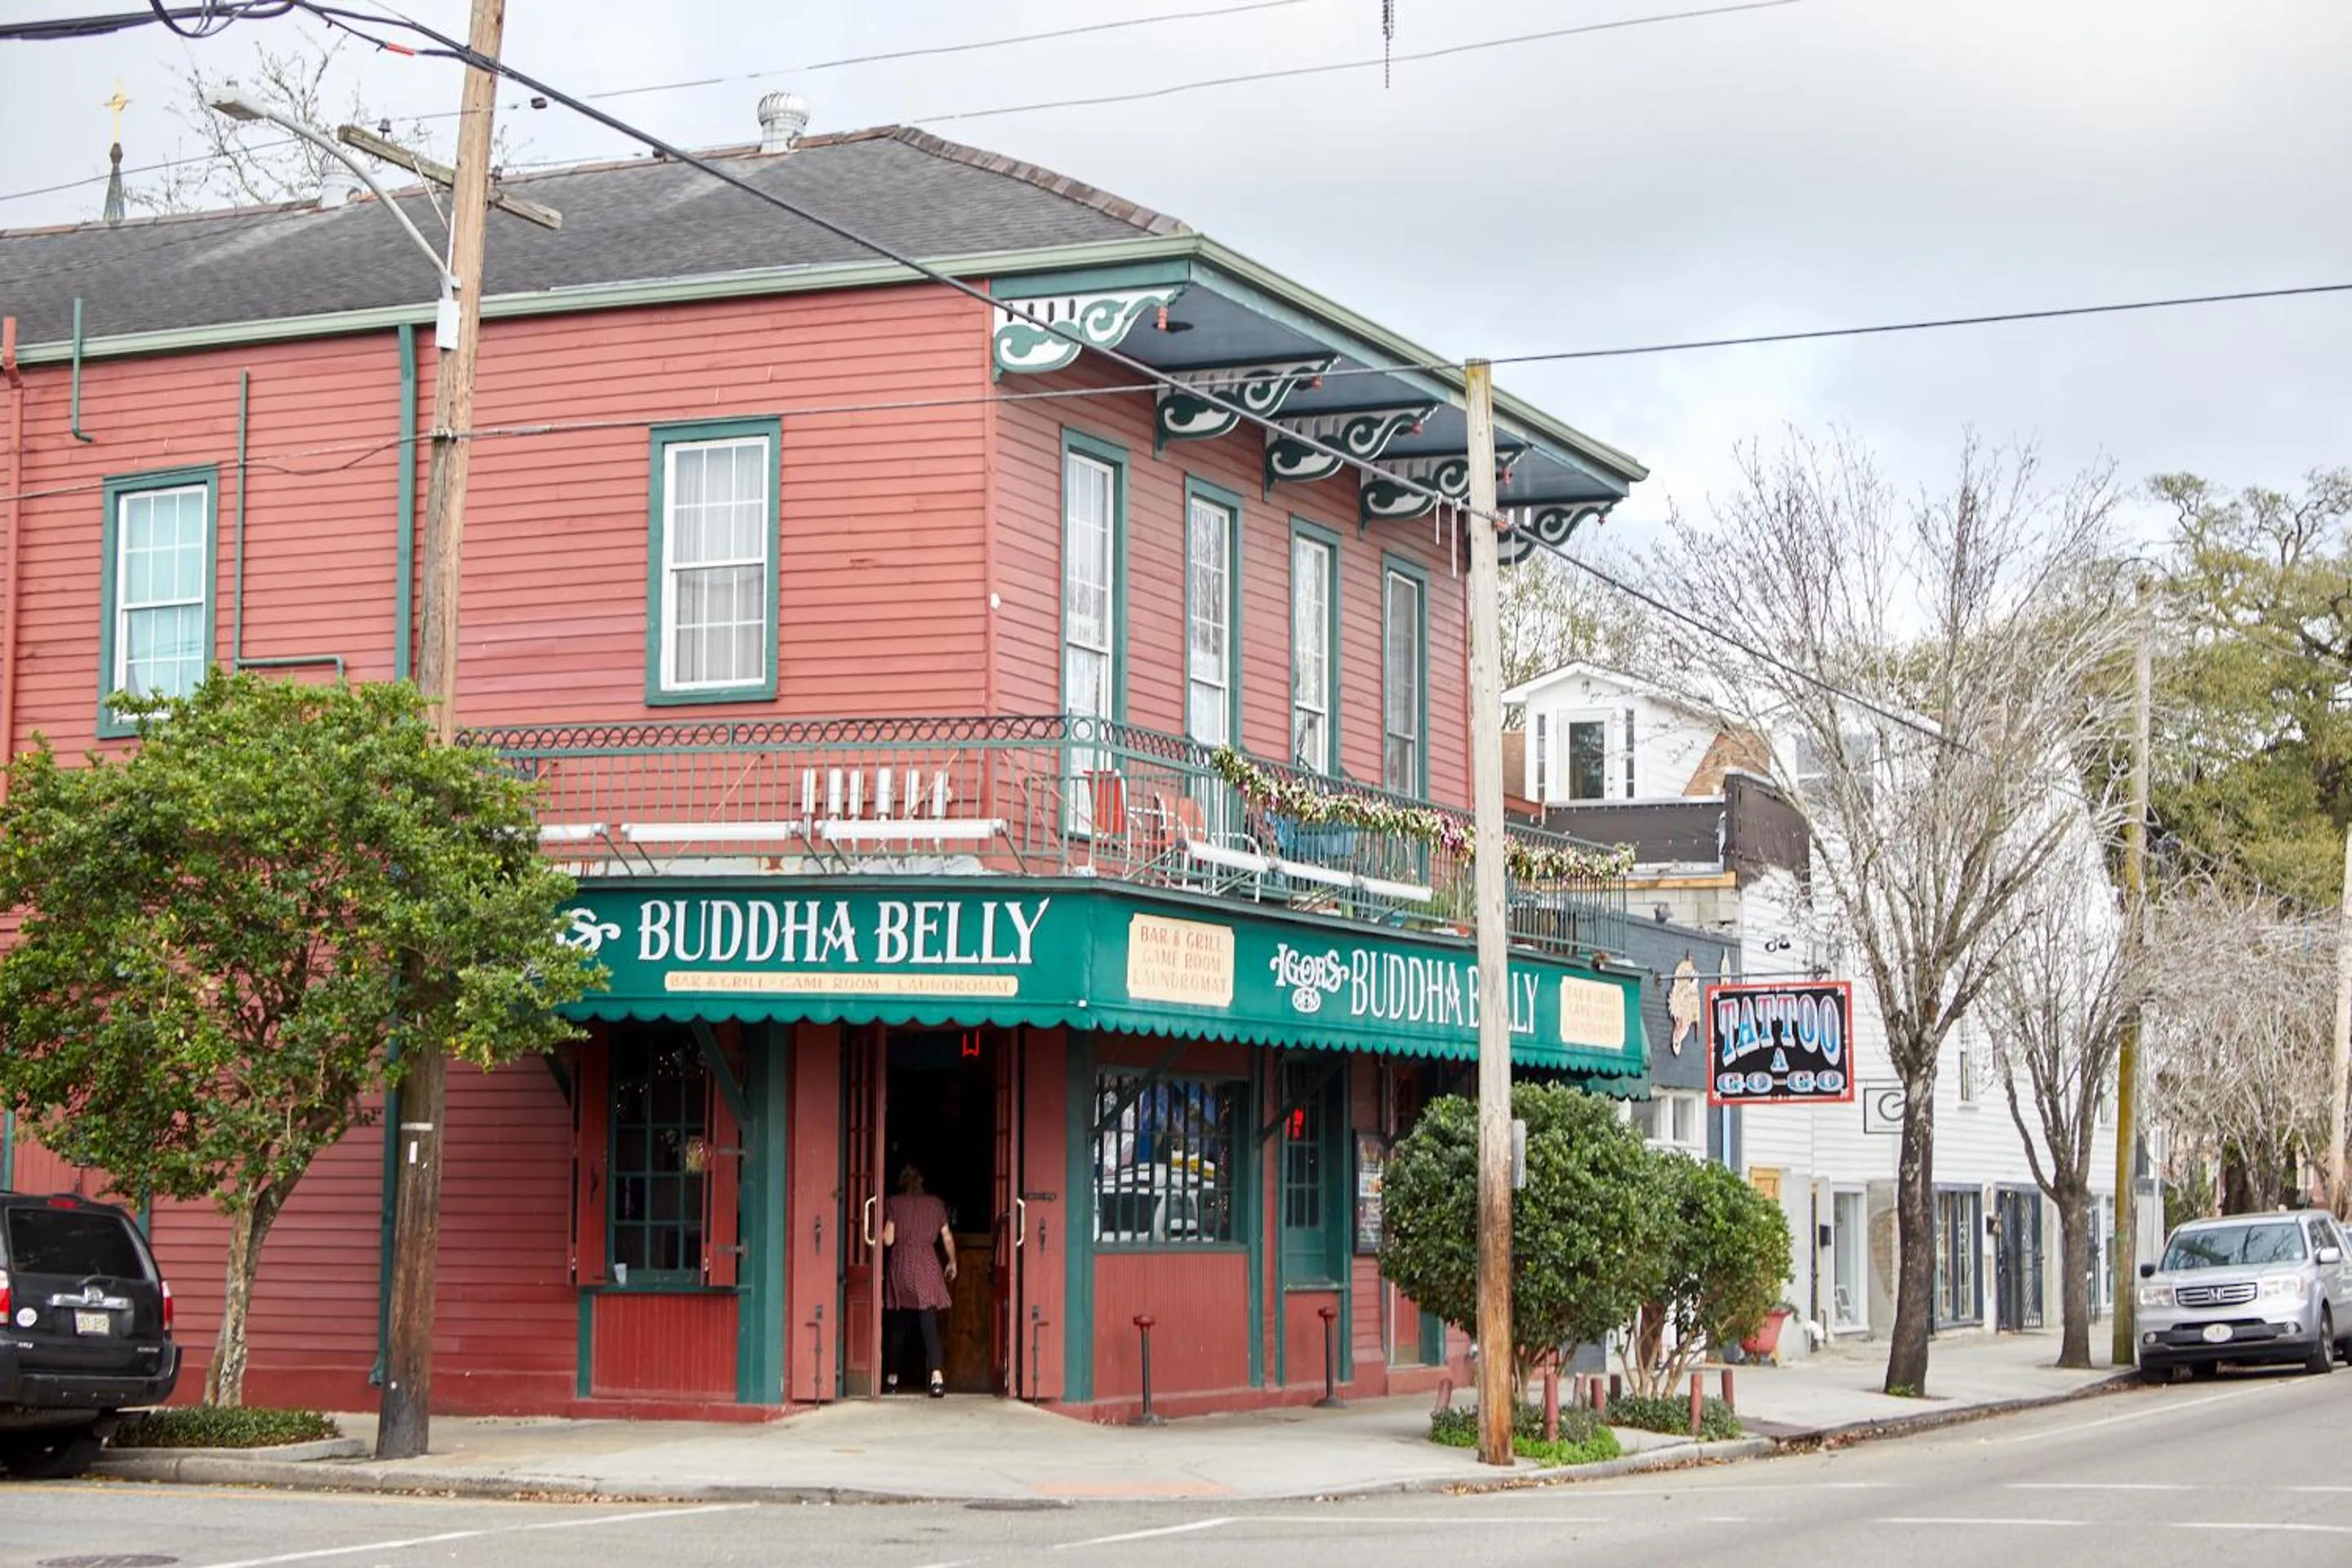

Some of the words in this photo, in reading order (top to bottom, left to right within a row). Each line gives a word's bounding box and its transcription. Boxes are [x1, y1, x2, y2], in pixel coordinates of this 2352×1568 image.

[637, 900, 858, 962] BUDDHA
[874, 897, 1050, 964] BELLY
[1140, 924, 1169, 945] BAR
[1173, 928, 1181, 947] &
[1186, 930, 1224, 953] GRILL
[1143, 947, 1178, 967] GAME
[1184, 951, 1222, 973] ROOM
[670, 974, 702, 988] BAR
[720, 975, 764, 990] GRILL
[781, 976, 825, 990] GAME
[833, 977, 880, 991] ROOM
[897, 978, 1009, 994] LAUNDROMAT
[1133, 967, 1228, 995] LAUNDROMAT
[1350, 948, 1464, 1027] BUDDHA
[1467, 964, 1539, 1035] BLY
[1717, 993, 1842, 1067] TATTOO
[1770, 1046, 1790, 1072] A
[1717, 1070, 1844, 1094] GO-GO
